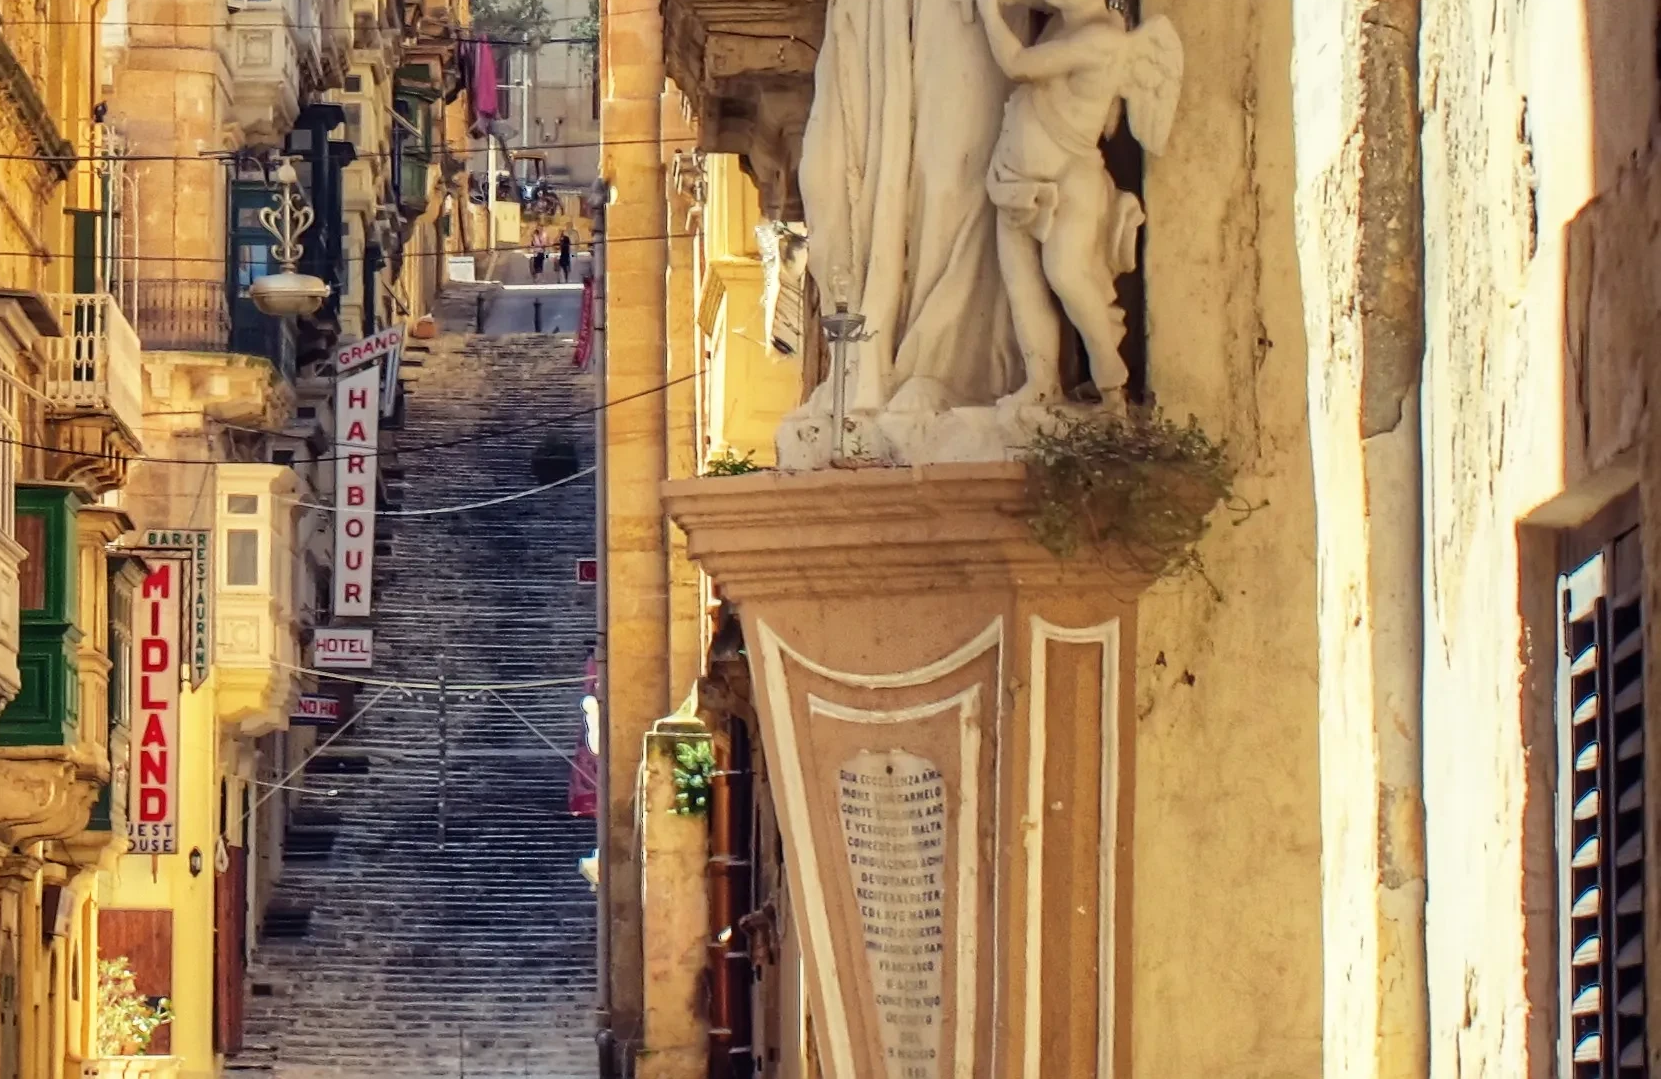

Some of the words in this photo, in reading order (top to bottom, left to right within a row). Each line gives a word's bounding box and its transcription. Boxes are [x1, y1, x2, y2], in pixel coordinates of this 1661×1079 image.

[340, 333, 400, 364] GRAND
[344, 389, 367, 603] HARBOUR
[148, 533, 181, 545] BAR
[195, 533, 206, 679] RESTAURANT
[316, 638, 370, 653] HOTEL
[140, 565, 170, 822] MIDLAND
[128, 824, 173, 836] UEST
[128, 839, 173, 852] OUSE
